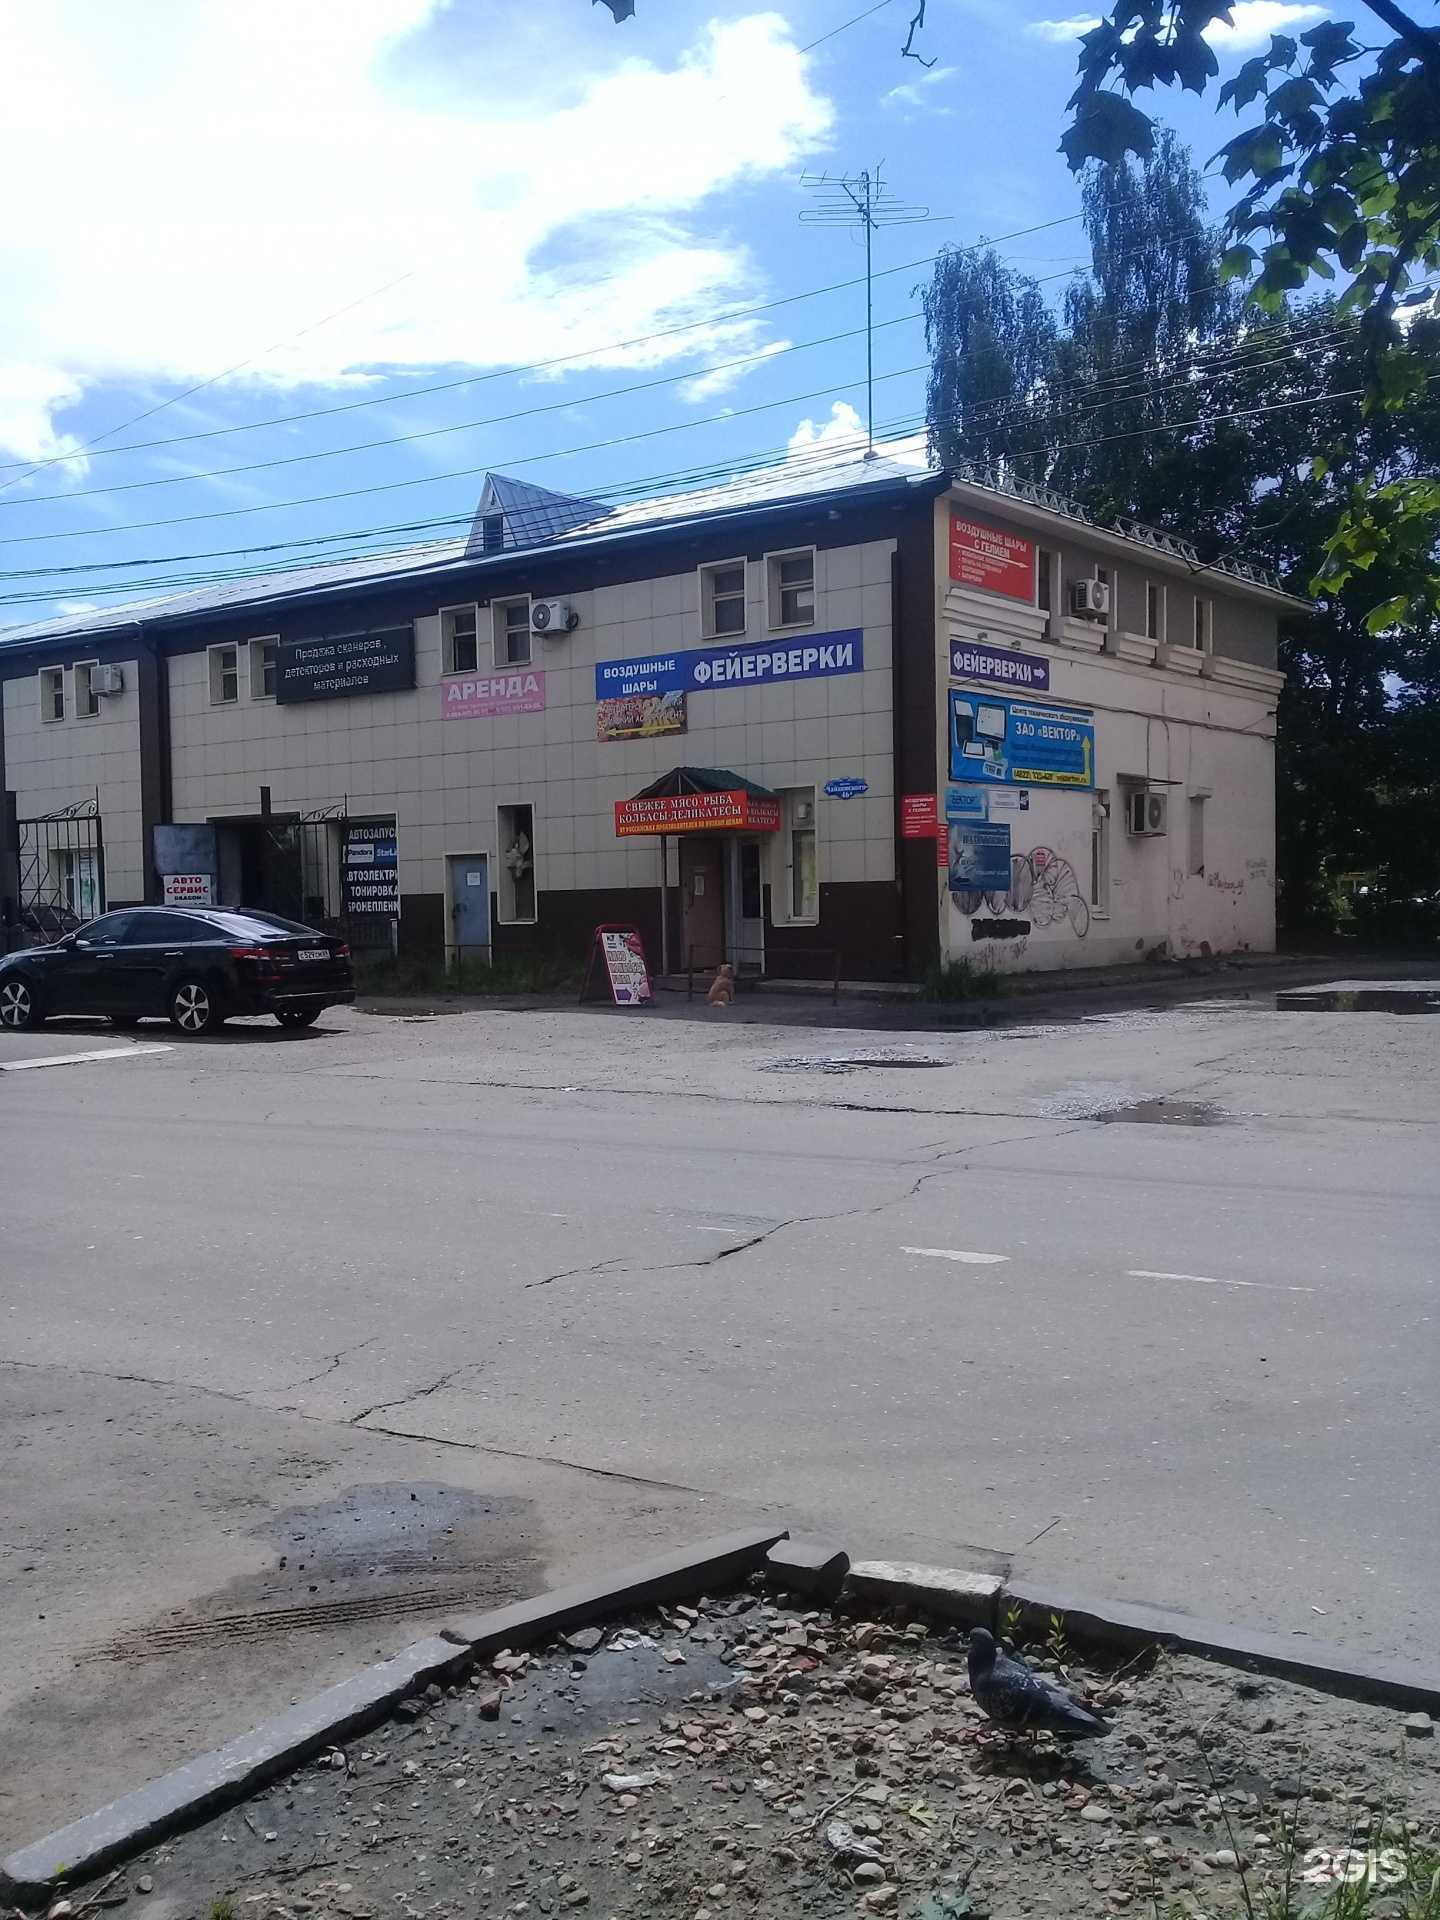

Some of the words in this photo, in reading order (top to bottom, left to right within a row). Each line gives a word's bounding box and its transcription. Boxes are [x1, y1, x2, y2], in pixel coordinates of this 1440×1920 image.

[956, 521, 1003, 544] ВОЗДУШНЫЕ
[1004, 536, 1027, 552] ШАРЫ
[974, 540, 980, 549] С
[981, 541, 1010, 558] ГЕЛИЕМ
[295, 645, 336, 661] Продажа
[345, 654, 400, 672] расходных
[603, 660, 676, 679] ВОЗДУШНЫЕ
[693, 643, 853, 684] ФЕЙЕРВЕРКИ
[953, 650, 1033, 682] ФЕЙЕРВЕРКИ
[313, 676, 369, 690] материалов
[447, 675, 539, 701] АРЕНДА
[622, 680, 657, 694] ШАРЫ
[1015, 721, 1035, 736] ЗАО
[625, 800, 666, 813] СВЕЖЕЕ
[671, 798, 699, 809] МЯСО
[703, 795, 733, 806] РЫБА
[619, 811, 667, 824] КОЛБАСЫ
[670, 805, 741, 821] ДЕЛИКАТЕСЫ
[172, 876, 202, 884] АВТО
[166, 886, 209, 894] СЕРВИС
[351, 885, 399, 897] ТОНИРОВКА
